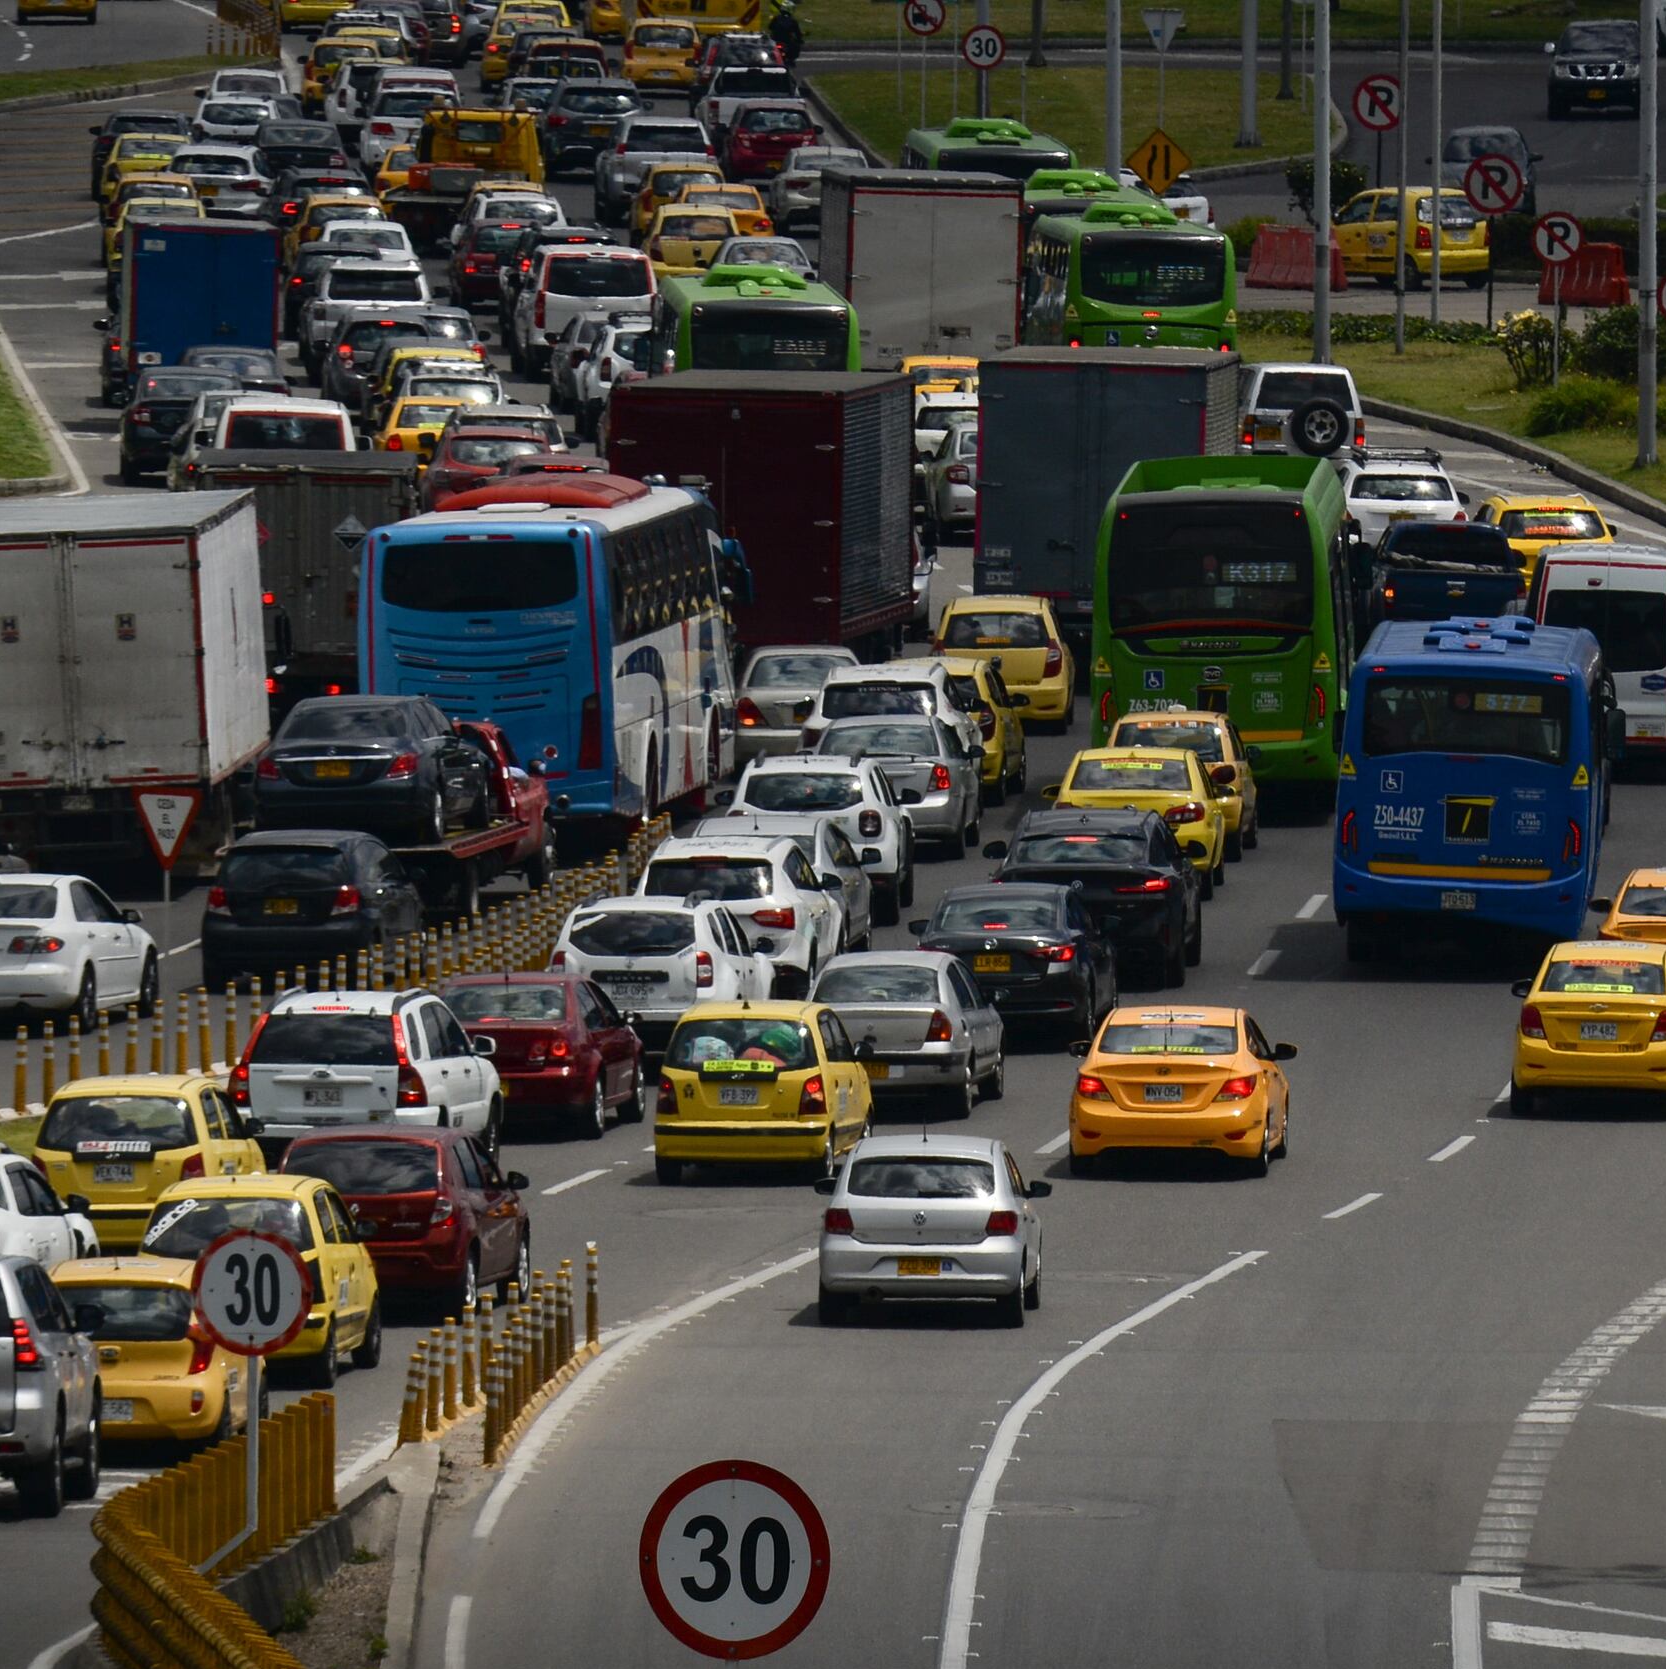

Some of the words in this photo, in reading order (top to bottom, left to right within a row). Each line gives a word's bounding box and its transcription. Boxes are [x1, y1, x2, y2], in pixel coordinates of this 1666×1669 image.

[972, 37, 998, 58] 30
[1374, 804, 1425, 828] Z50-4437
[224, 1252, 280, 1327] 30
[680, 1514, 791, 1606] 30
